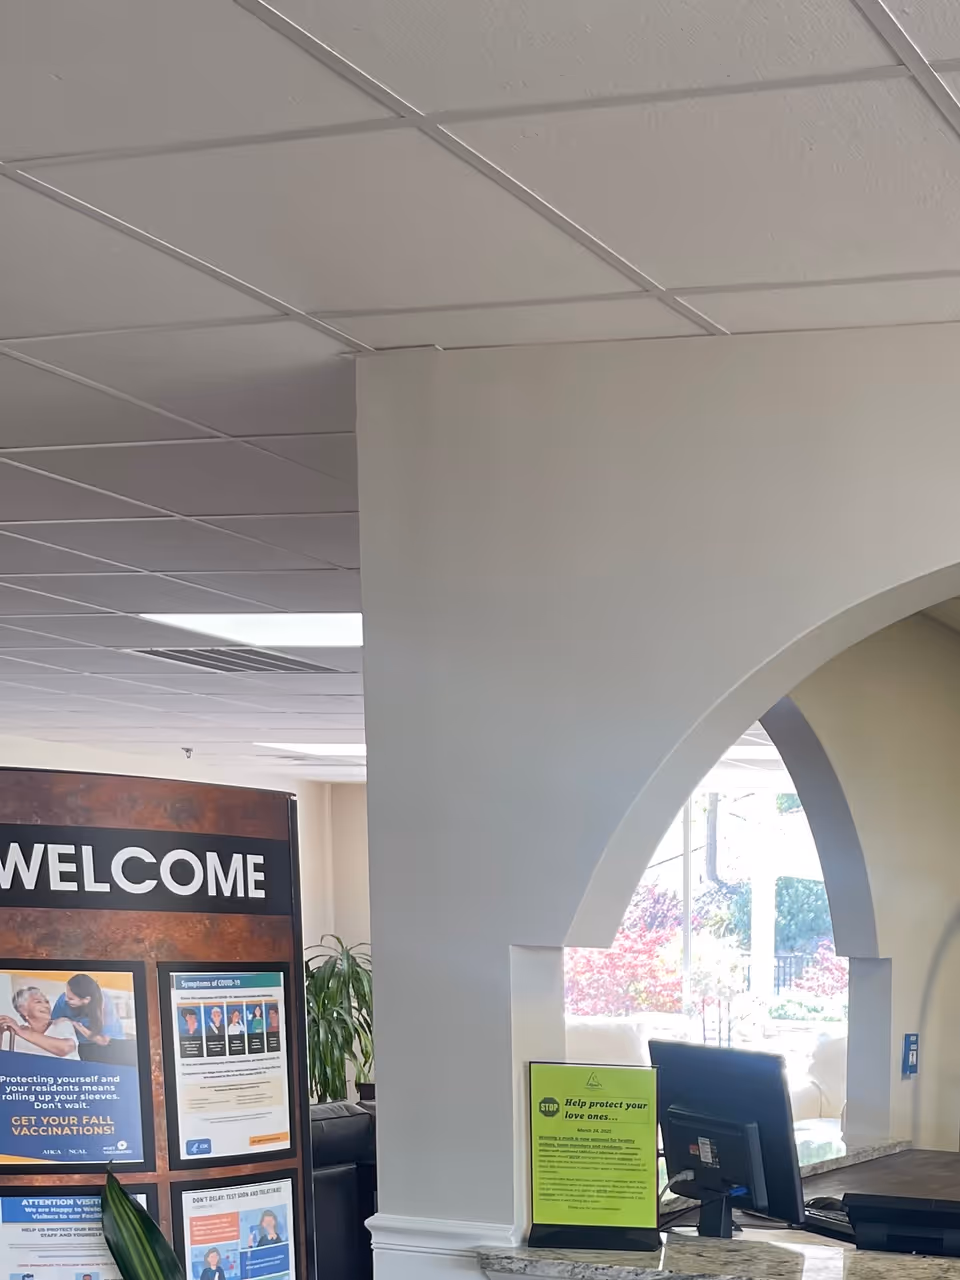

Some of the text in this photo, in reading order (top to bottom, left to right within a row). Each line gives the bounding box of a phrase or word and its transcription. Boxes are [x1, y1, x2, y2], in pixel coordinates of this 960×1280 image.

[0, 842, 266, 899] WELCOME
[181, 980, 211, 988] Symptoms
[0, 1075, 120, 1084] Protecting yourself and
[5, 1085, 28, 1093] your
[31, 1084, 79, 1092] residents
[2, 1093, 35, 1102] rolling
[54, 1094, 77, 1102] your
[80, 1092, 120, 1100] sleeves.
[540, 1103, 558, 1112] STOP
[564, 1099, 648, 1111] Help protect your
[11, 1115, 115, 1125] GET YOUR FALL
[564, 1111, 618, 1121] love ones...
[11, 1126, 115, 1135] VACCINATIONS!
[21, 1198, 74, 1206] ATTENTION
